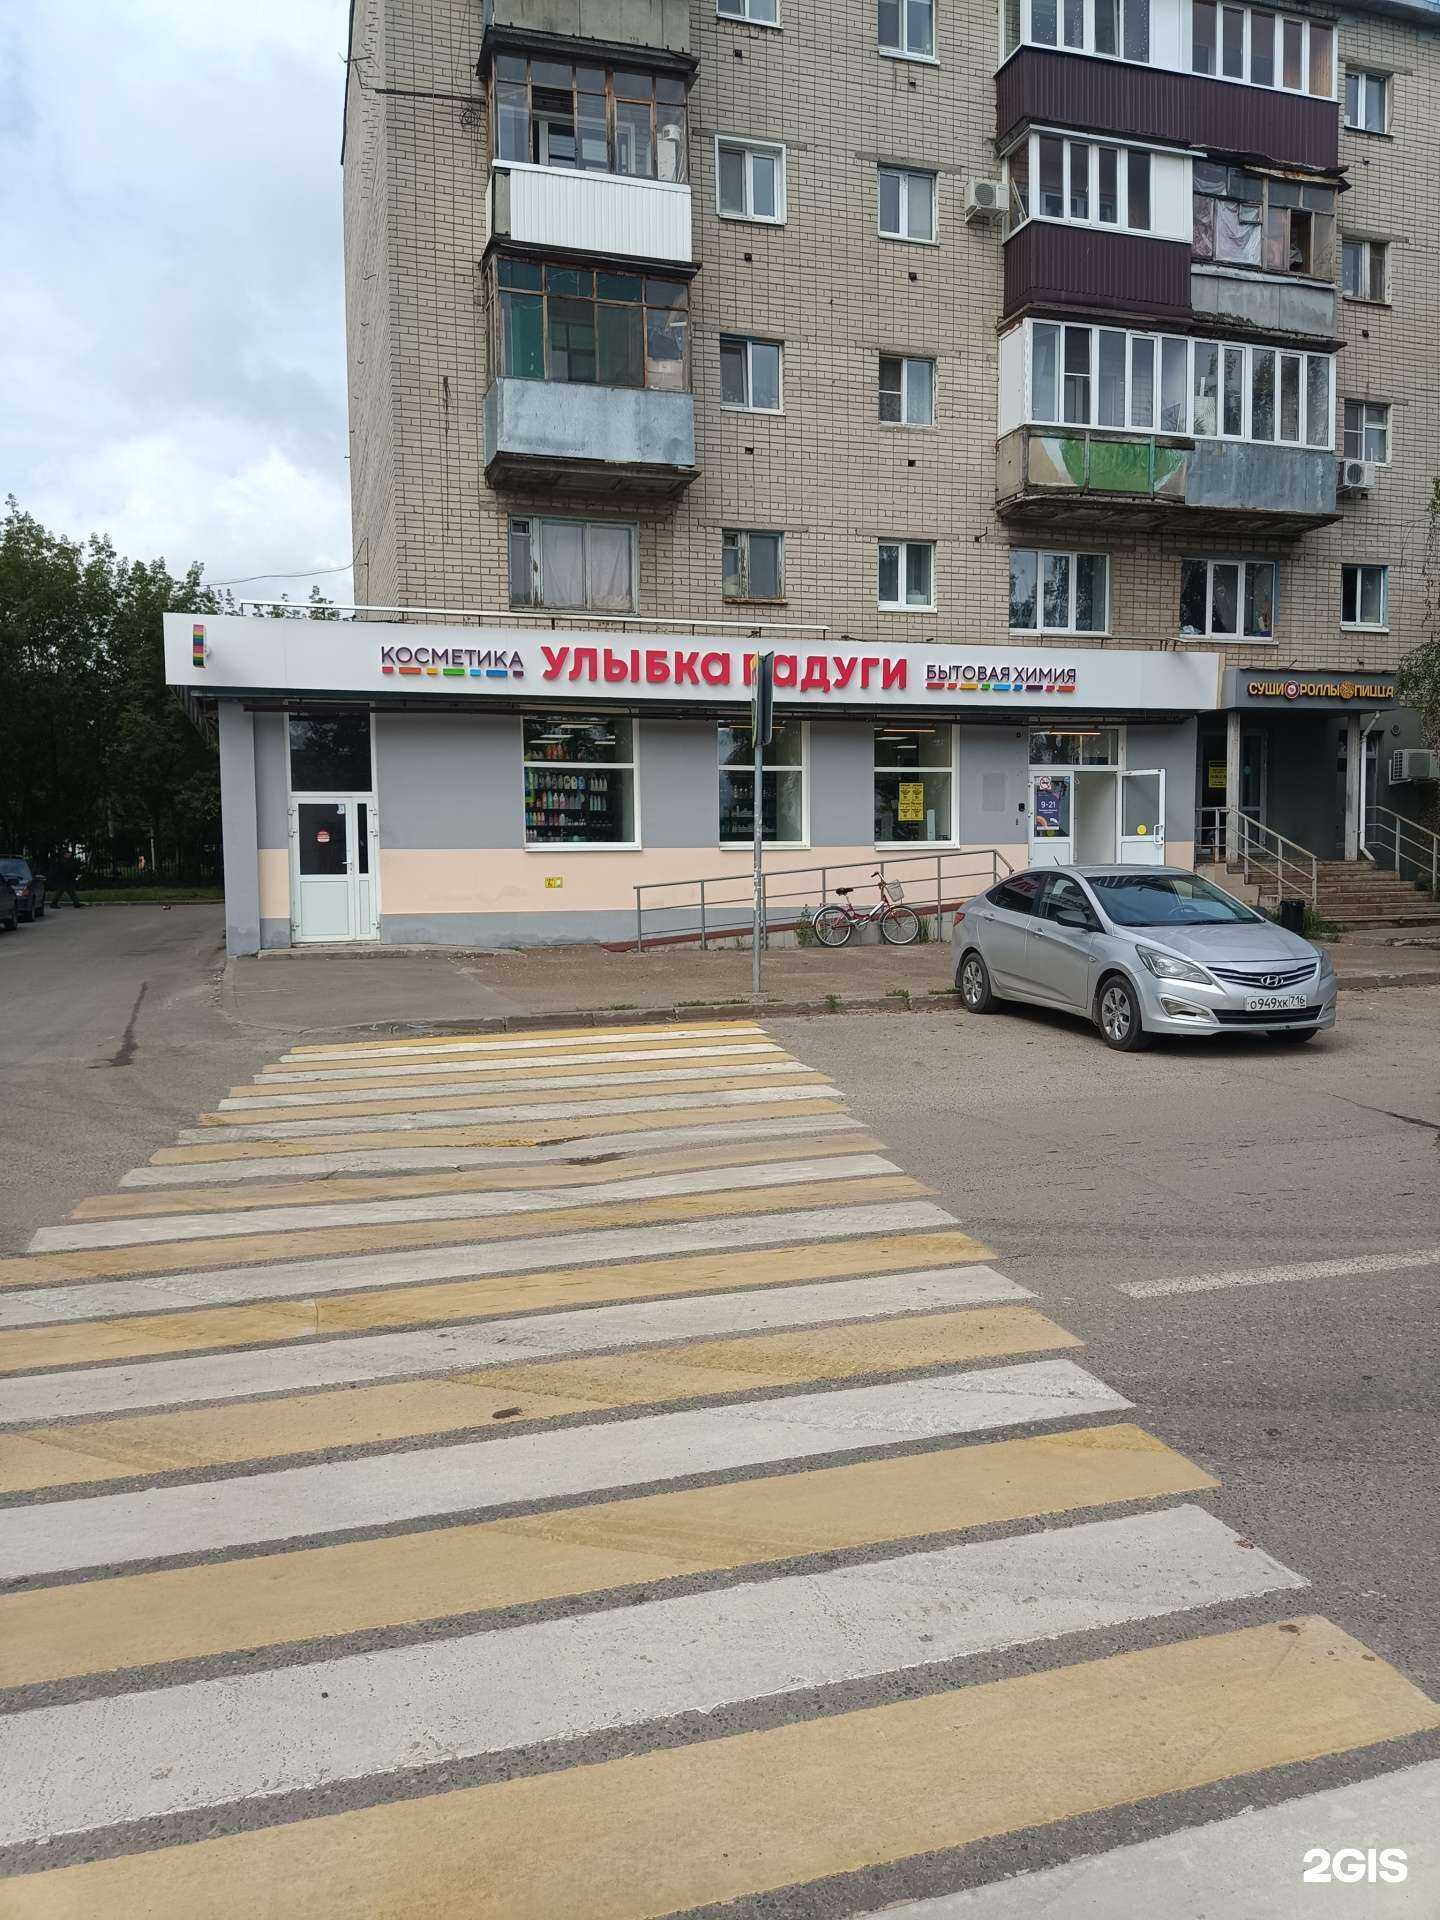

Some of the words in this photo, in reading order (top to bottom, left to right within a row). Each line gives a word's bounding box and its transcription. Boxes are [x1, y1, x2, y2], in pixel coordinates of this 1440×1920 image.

[381, 646, 524, 668] КОСМЕТИКА
[926, 664, 1010, 681] БЫТОВАЯ
[1012, 666, 1077, 683] ХИМИЯ
[1248, 682, 1285, 696] СУШИ
[1300, 683, 1340, 697] РОЛЛЫ
[1354, 685, 1395, 699] ПИЦЦА
